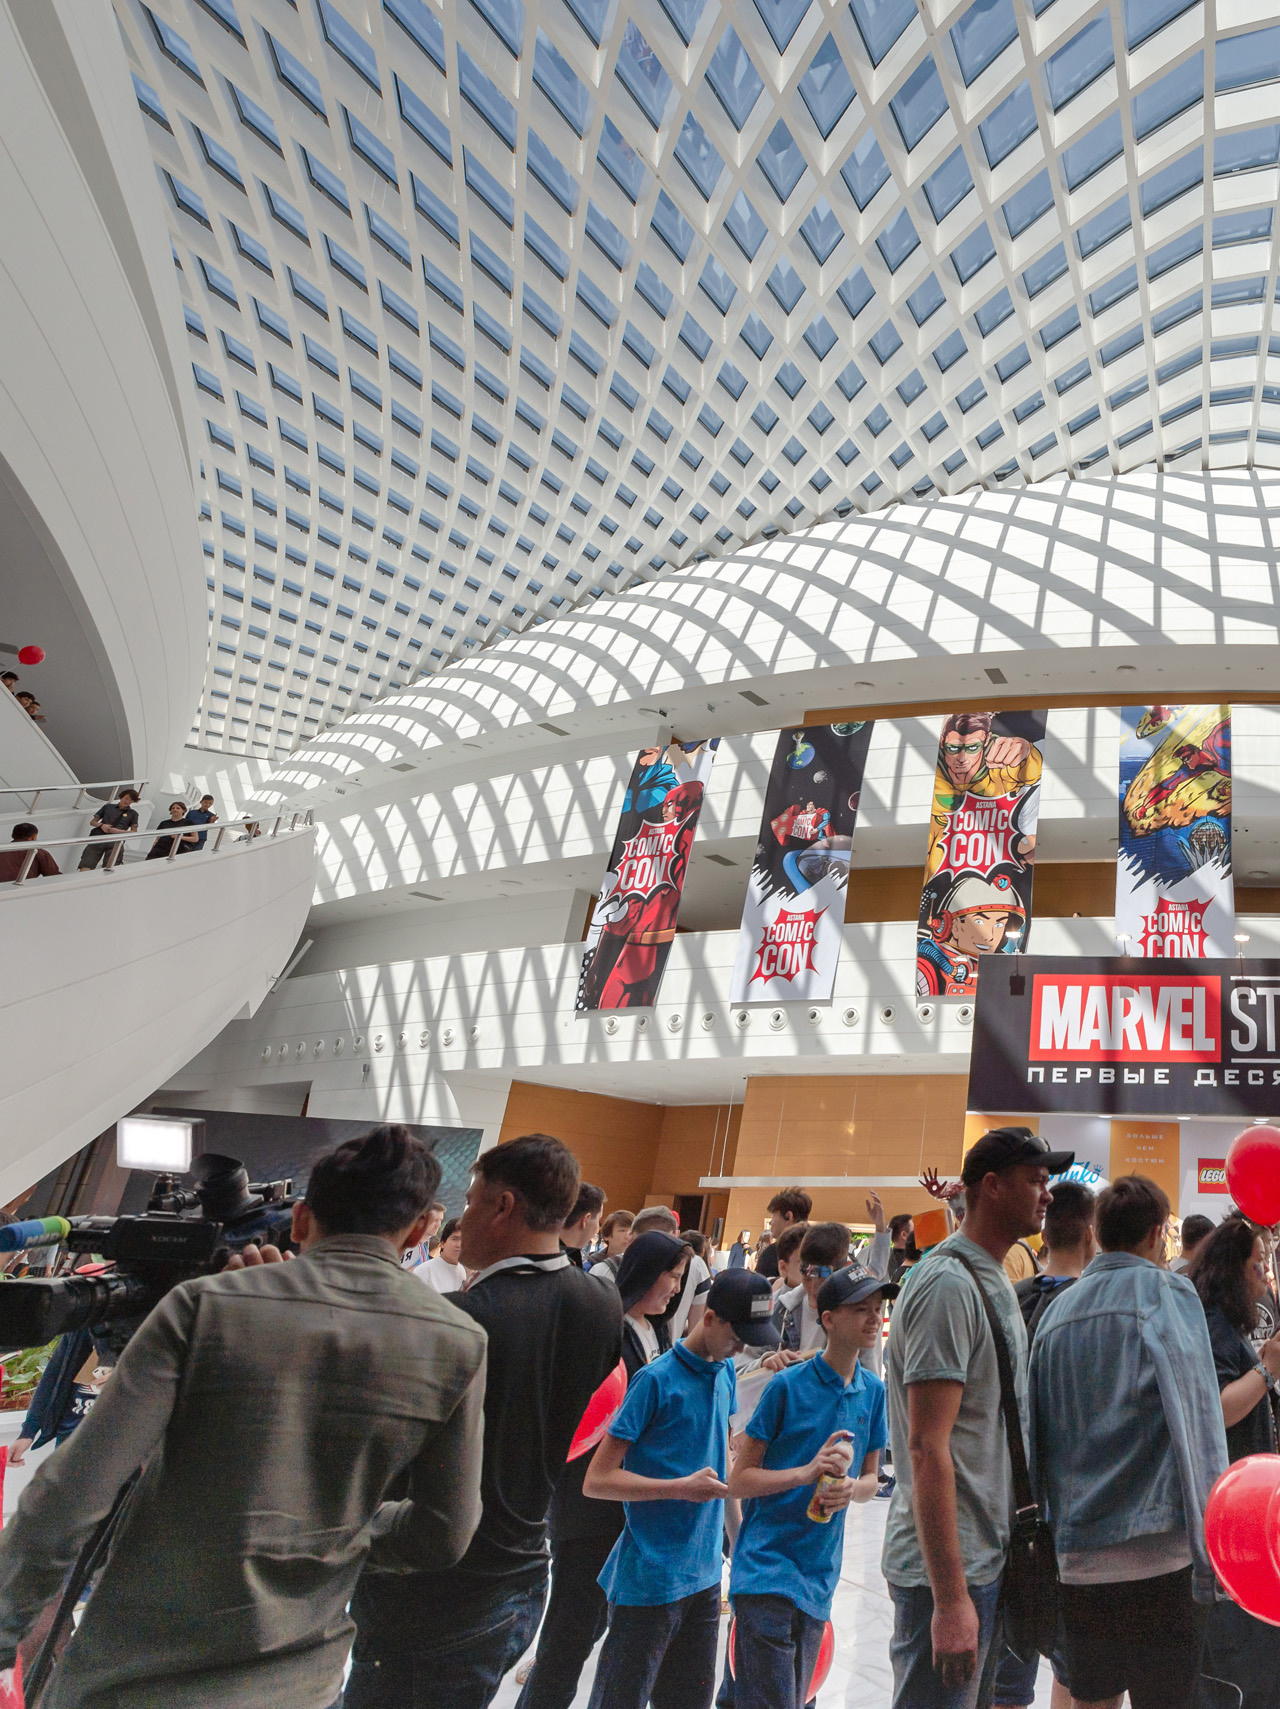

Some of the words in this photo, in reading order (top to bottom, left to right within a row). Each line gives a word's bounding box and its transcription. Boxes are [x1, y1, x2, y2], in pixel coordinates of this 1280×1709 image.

[949, 832, 1004, 867] CON
[620, 856, 667, 890] CON
[761, 943, 809, 976] CON
[1147, 934, 1199, 958] CON
[1039, 985, 1216, 1051] MARVEL
[1027, 1066, 1170, 1085] ПЕРВЫЕ
[1200, 1168, 1226, 1183] LEGO
